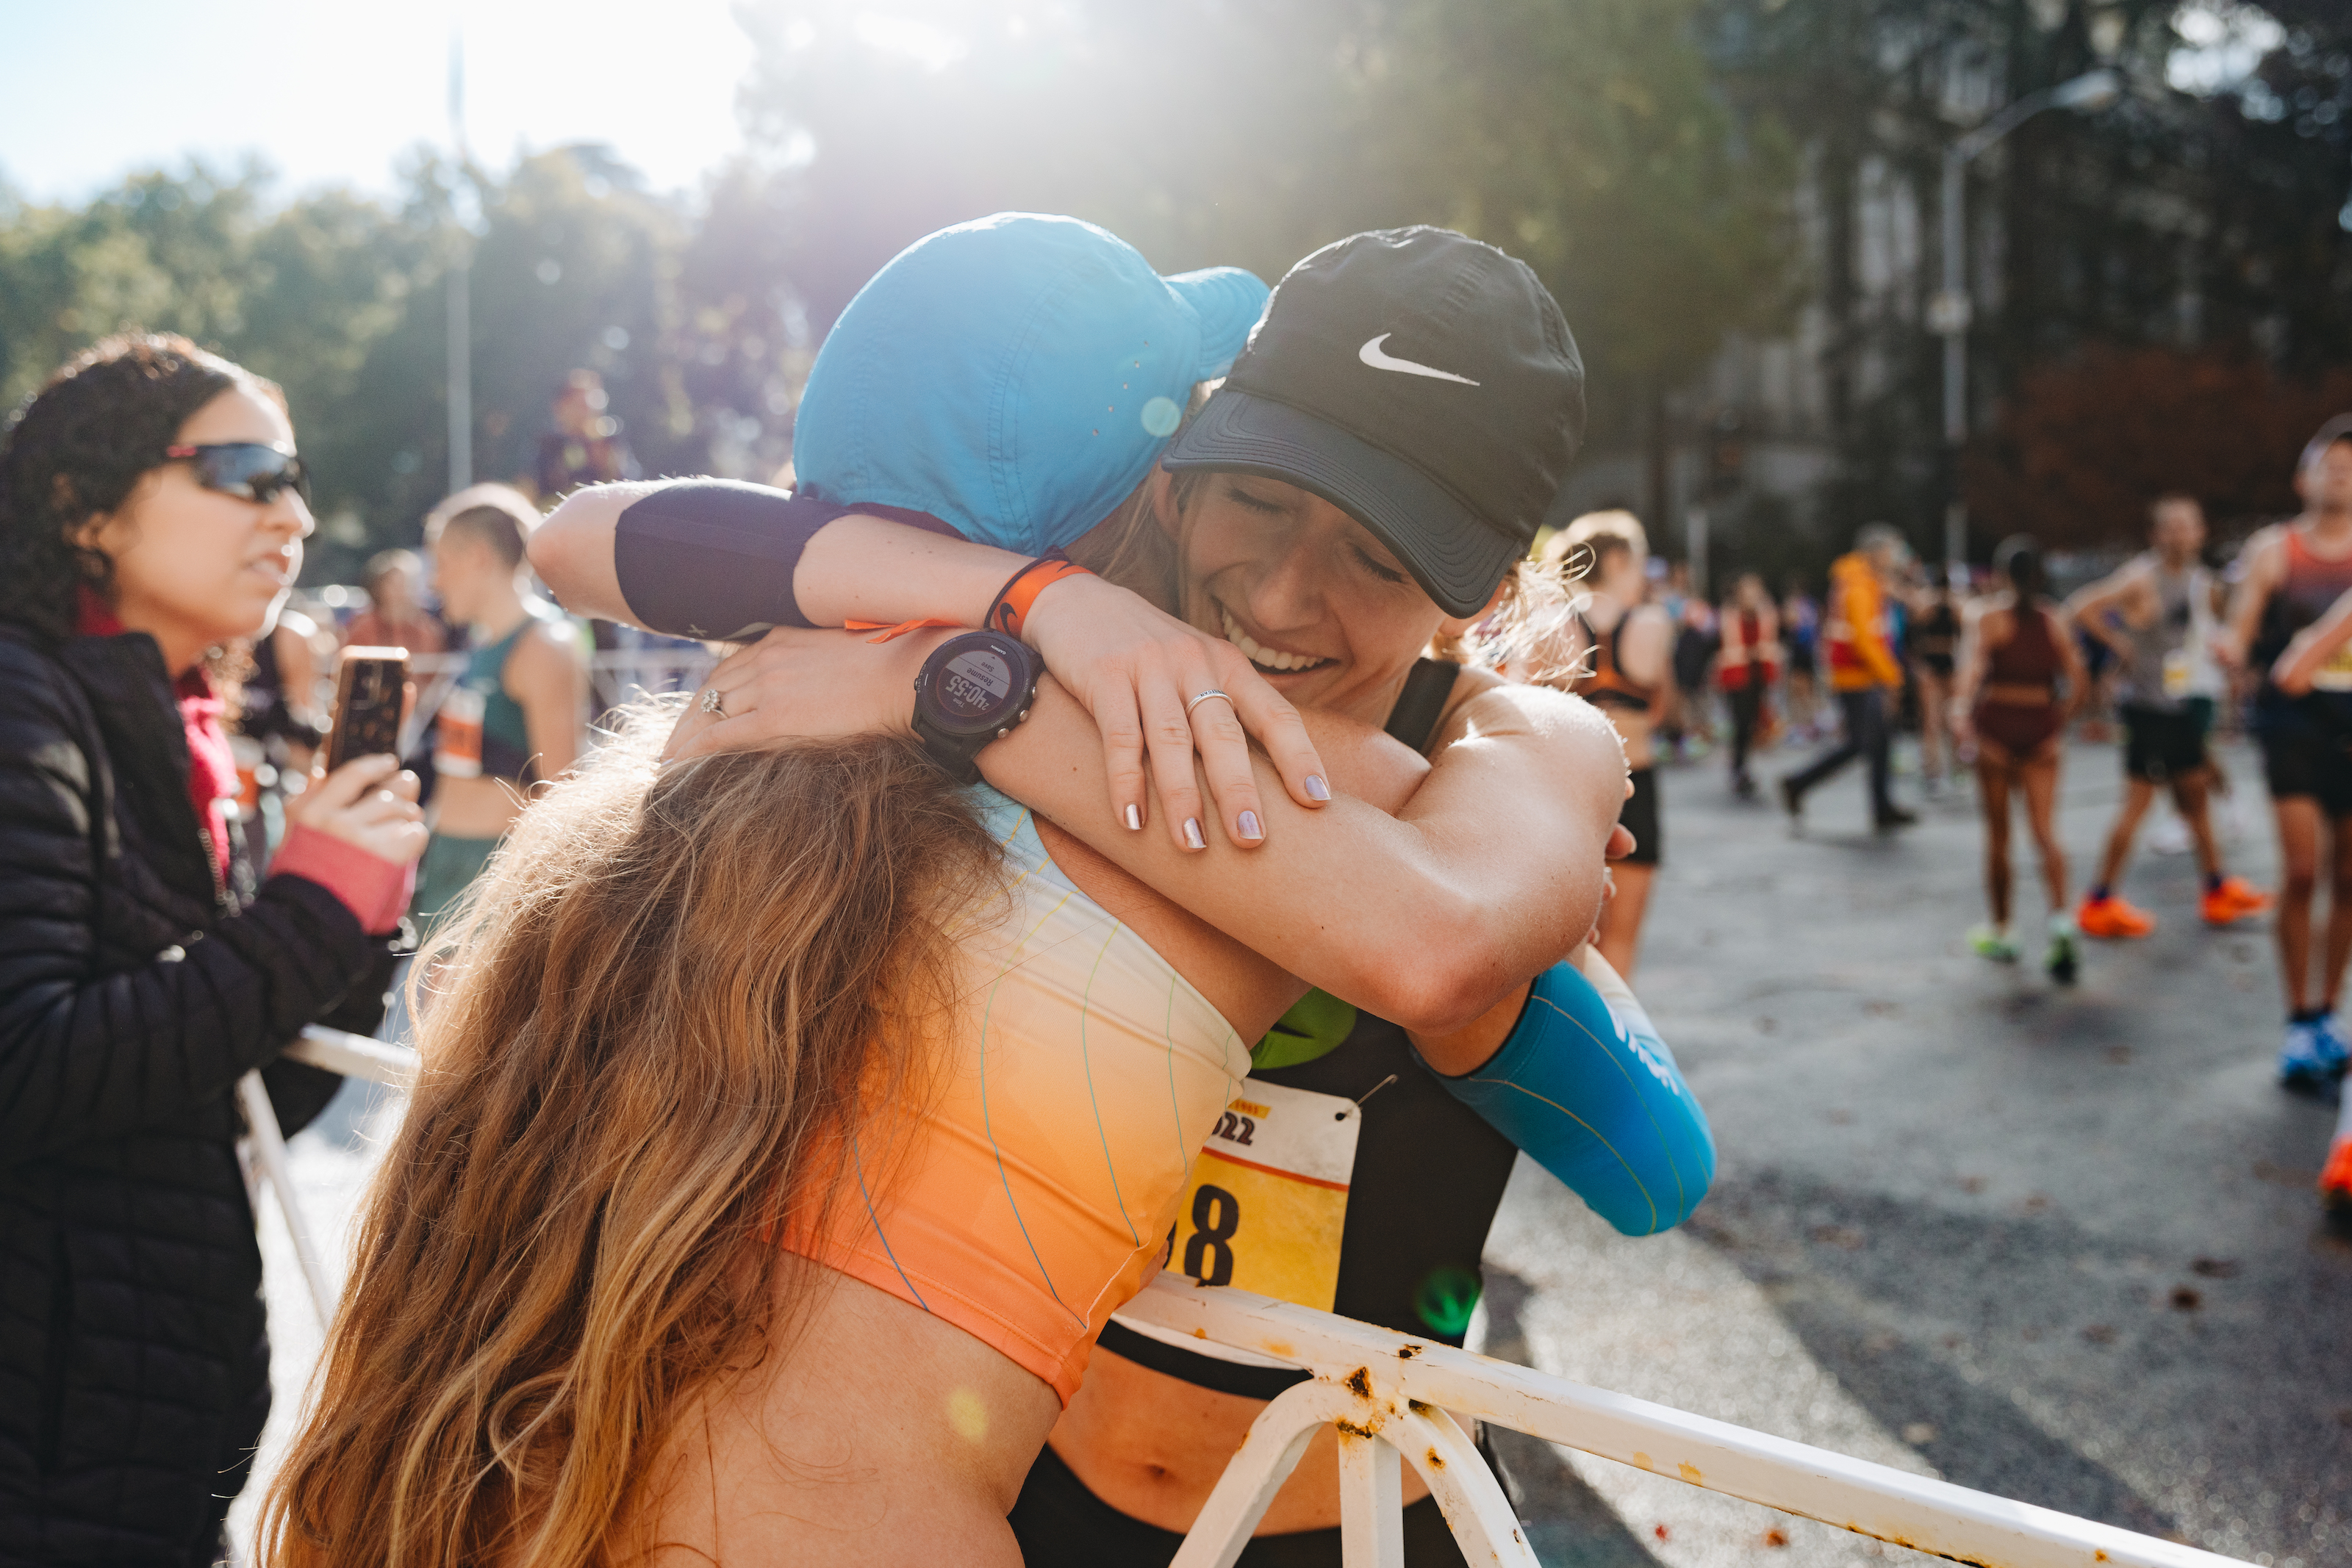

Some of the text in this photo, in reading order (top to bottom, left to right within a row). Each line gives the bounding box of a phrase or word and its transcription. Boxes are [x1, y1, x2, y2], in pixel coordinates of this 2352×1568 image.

[990, 644, 1006, 655] GARMIN
[980, 661, 994, 672] Save
[967, 667, 994, 687] Resume
[953, 697, 965, 708] Time
[1162, 1183, 1240, 1288] 8
